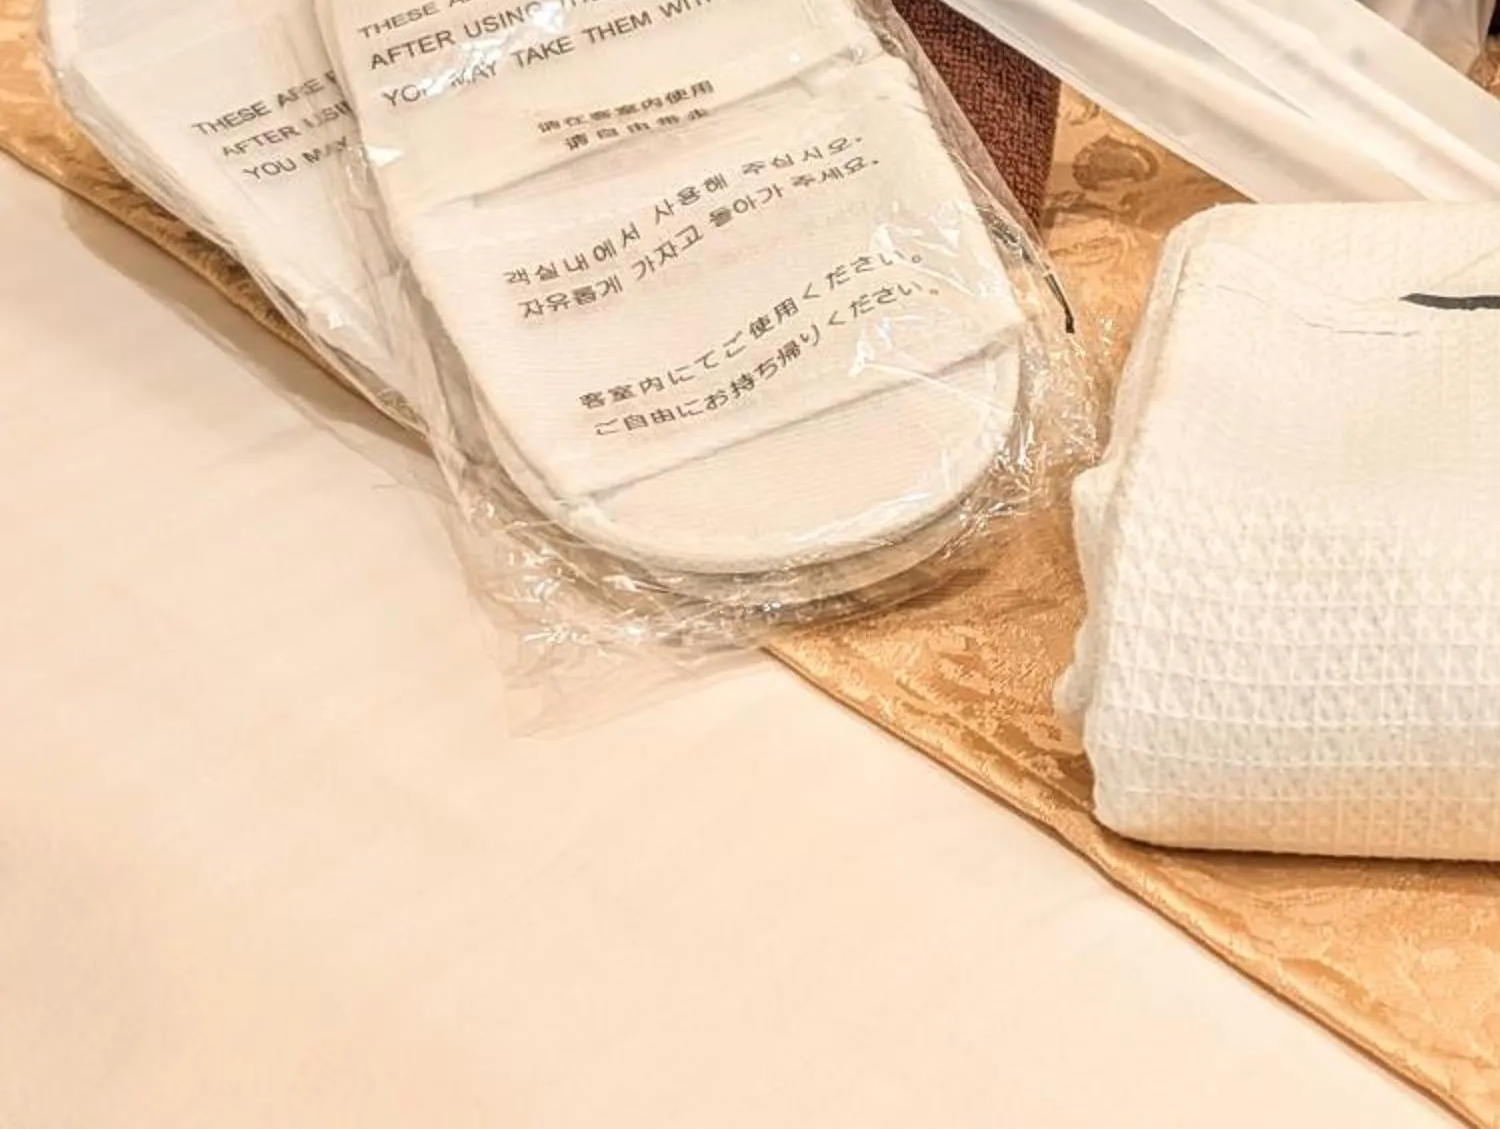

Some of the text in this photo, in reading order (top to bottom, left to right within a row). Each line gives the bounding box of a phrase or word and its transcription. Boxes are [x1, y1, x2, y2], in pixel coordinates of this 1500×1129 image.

[357, 0, 440, 39] THESE
[370, 30, 456, 70] AFTER
[382, 78, 436, 108] YO
[512, 35, 575, 68] TAKE
[582, 10, 653, 44] THEM
[191, 100, 272, 136] THESE
[222, 124, 302, 157] AFTER
[243, 157, 298, 180] YOU
[653, 173, 728, 226] 사용해
